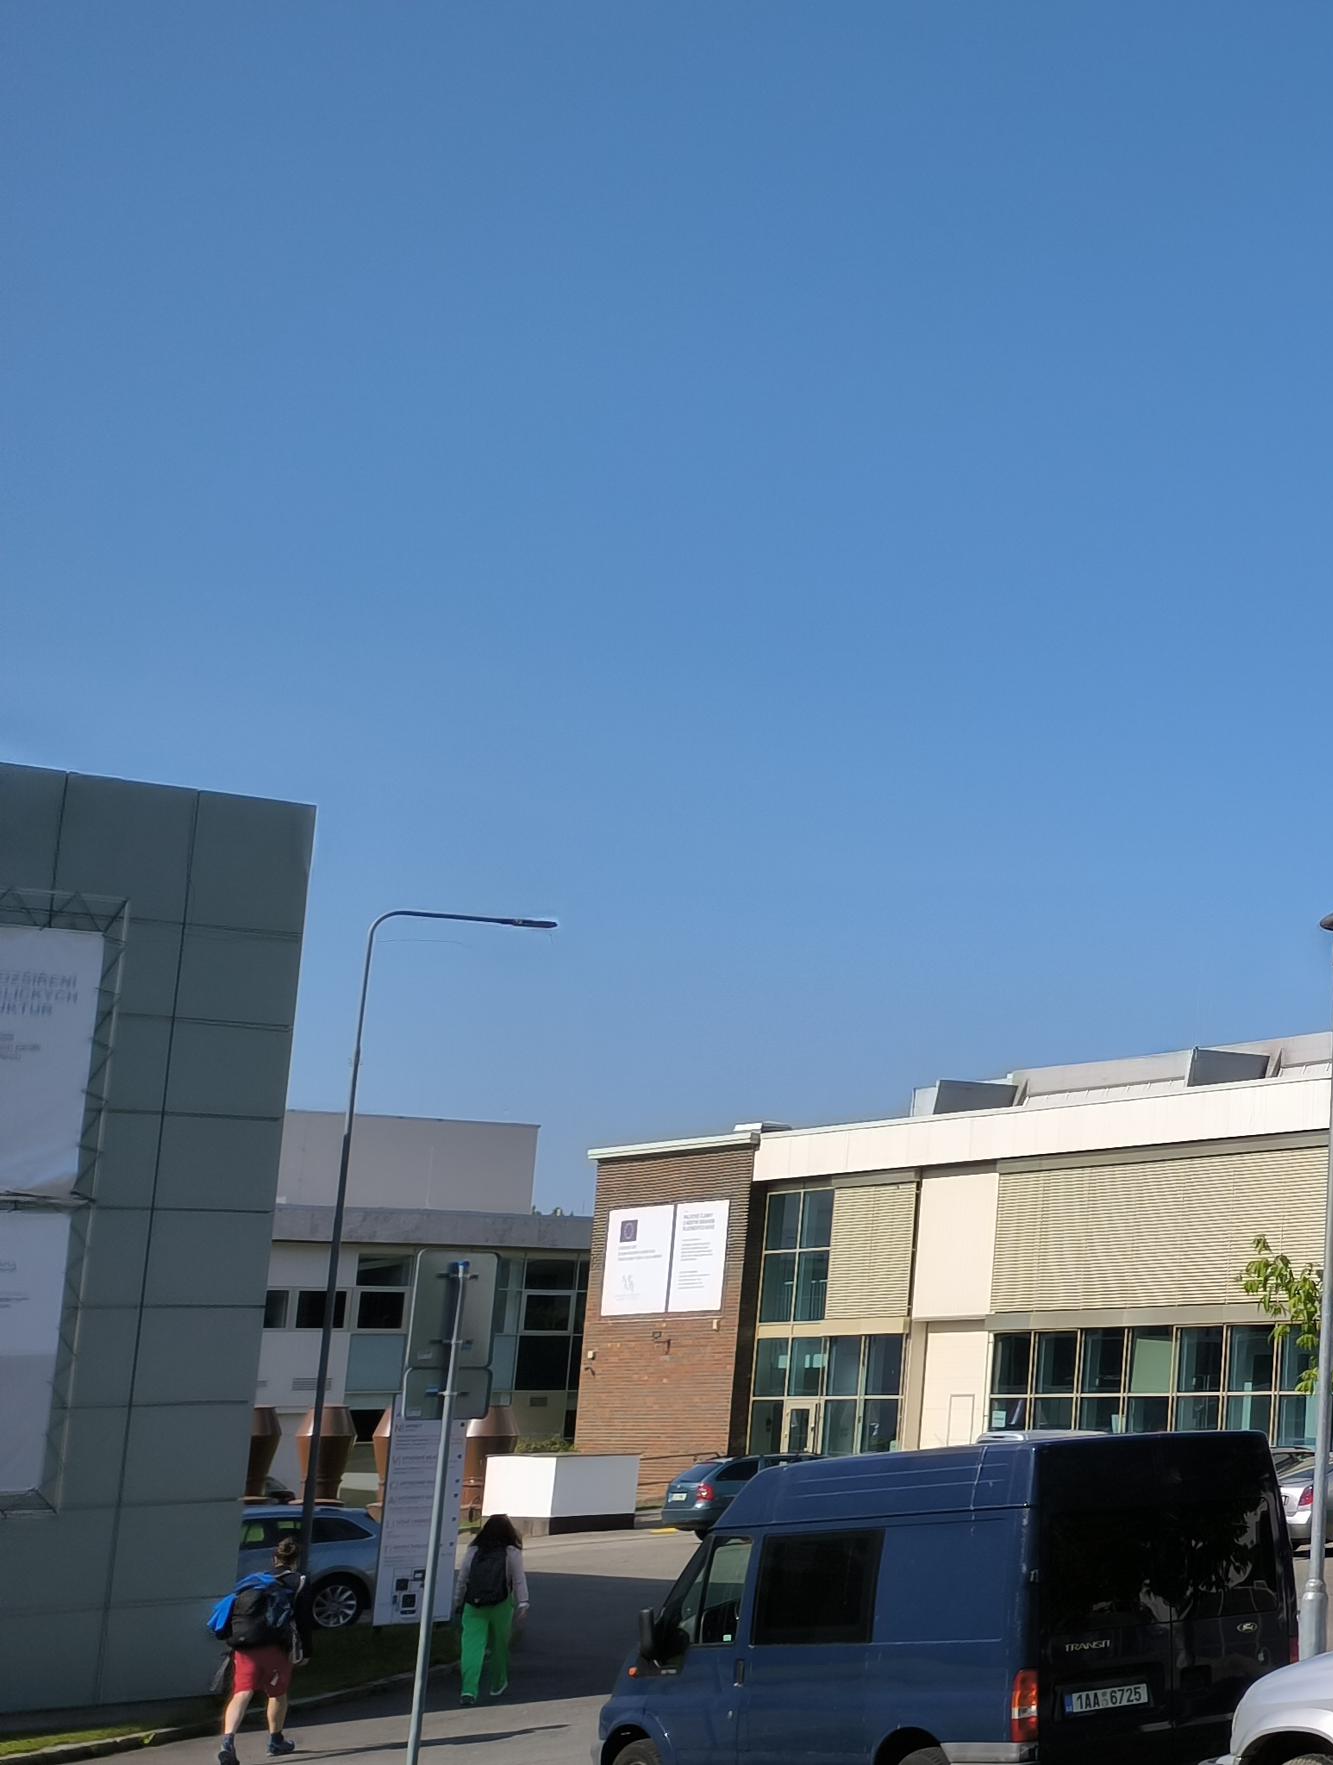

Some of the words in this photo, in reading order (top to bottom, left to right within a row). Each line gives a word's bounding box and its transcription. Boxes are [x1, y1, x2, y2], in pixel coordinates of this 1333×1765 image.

[1065, 1640, 1111, 1652] TRANSIT
[1076, 1692, 1100, 1710] 1AA
[1109, 1686, 1142, 1706] 6725
